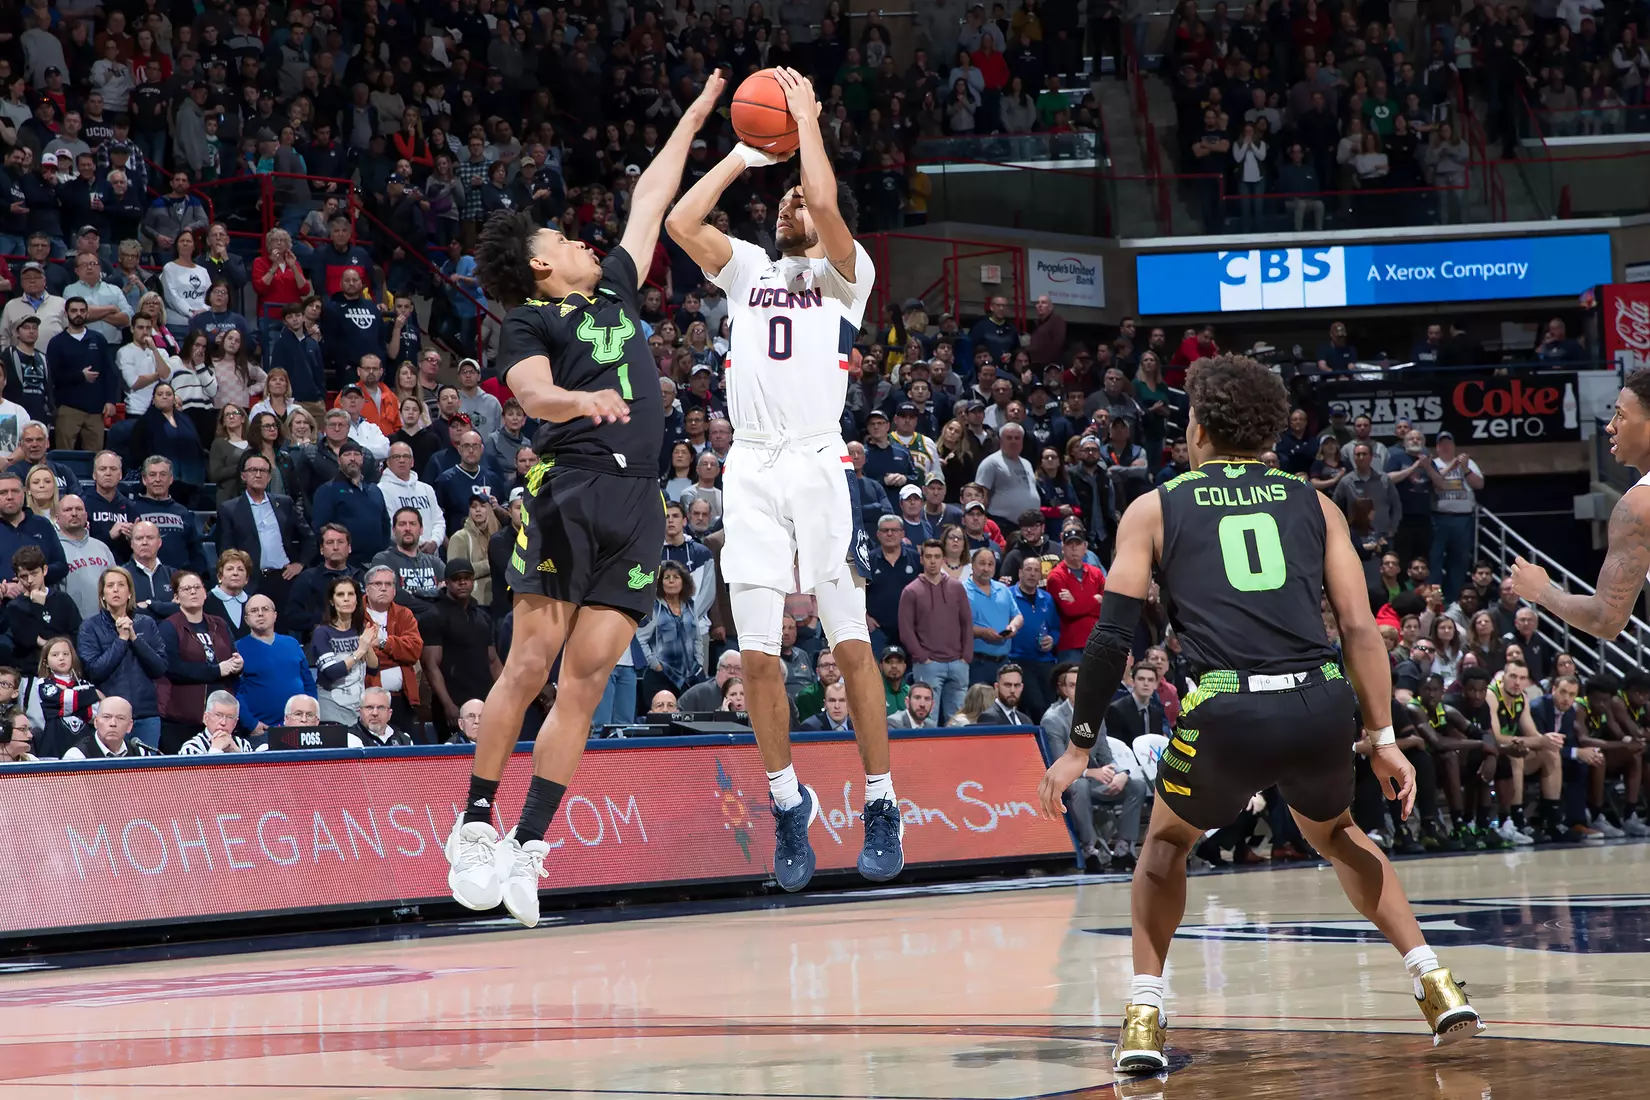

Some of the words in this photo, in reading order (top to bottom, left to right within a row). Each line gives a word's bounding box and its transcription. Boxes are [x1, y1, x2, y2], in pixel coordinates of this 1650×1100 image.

[1037, 260, 1069, 274] People's
[1069, 263, 1095, 276] United
[1075, 275, 1095, 286] Bank
[1218, 246, 1331, 286] CBS
[1367, 264, 1381, 281] A
[1385, 263, 1436, 281] Xerox
[1440, 260, 1529, 281] Company
[748, 286, 823, 310] UCONN
[768, 315, 793, 361] 0
[617, 363, 634, 400] 1
[1452, 379, 1559, 418] Coke
[1471, 416, 1544, 439] zero
[1193, 483, 1288, 507] COLLINS
[1218, 511, 1287, 592] 0
[300, 731, 324, 747] POSS.
[817, 780, 959, 844] ohan
[955, 779, 1038, 833] Sun
[65, 794, 649, 880] MOHEGANSUOM
